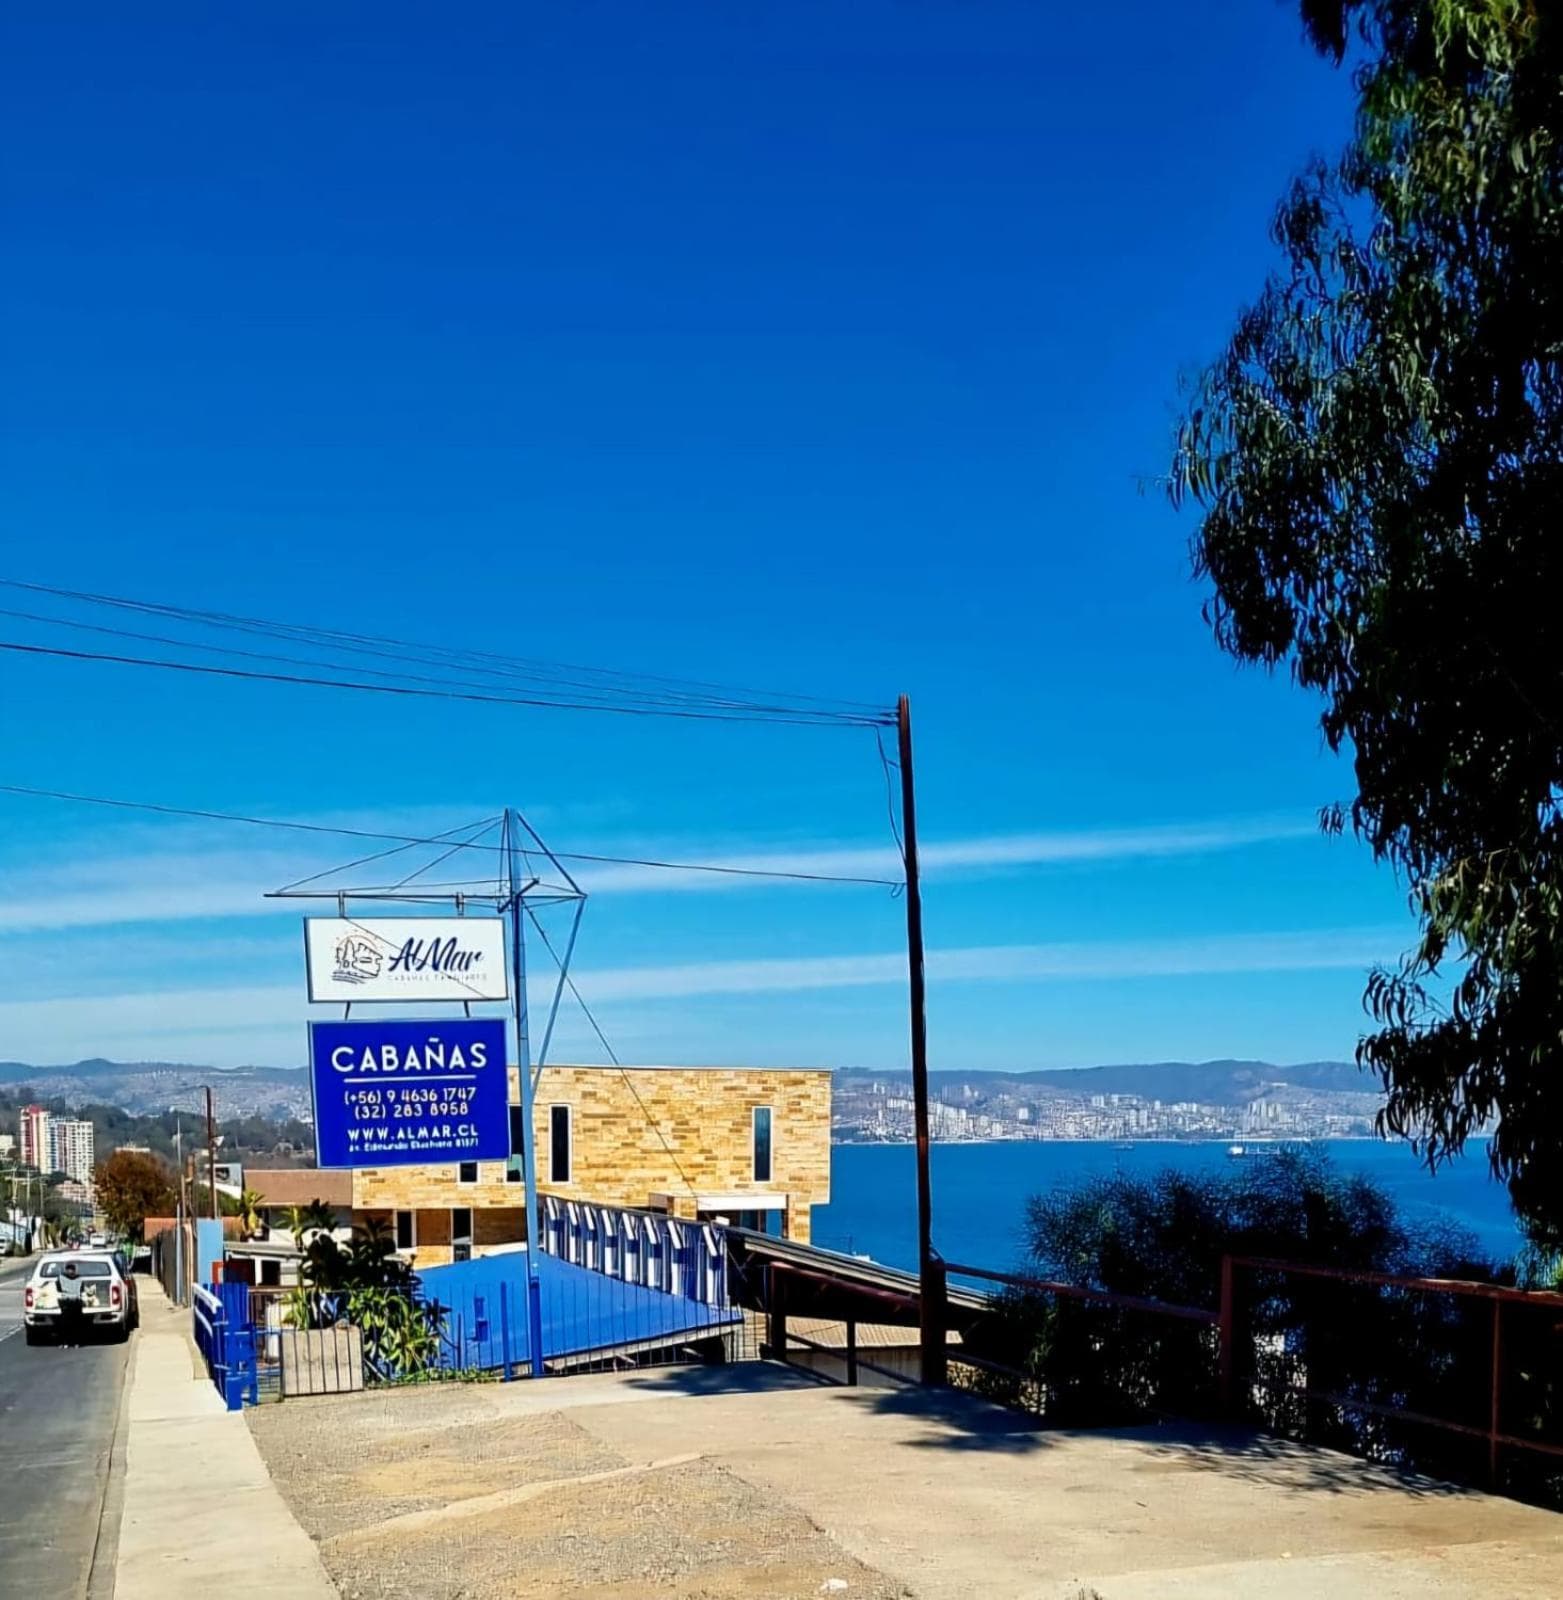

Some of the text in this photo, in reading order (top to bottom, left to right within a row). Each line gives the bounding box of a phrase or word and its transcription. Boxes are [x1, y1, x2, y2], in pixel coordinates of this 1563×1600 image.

[331, 1036, 487, 1073] CABAÑAS
[344, 1086, 477, 1106] (+56) 9 4636 1747
[354, 1103, 387, 1120] (32)
[393, 1103, 423, 1118] 283
[347, 1123, 479, 1141] WWW.ALMAR.CL
